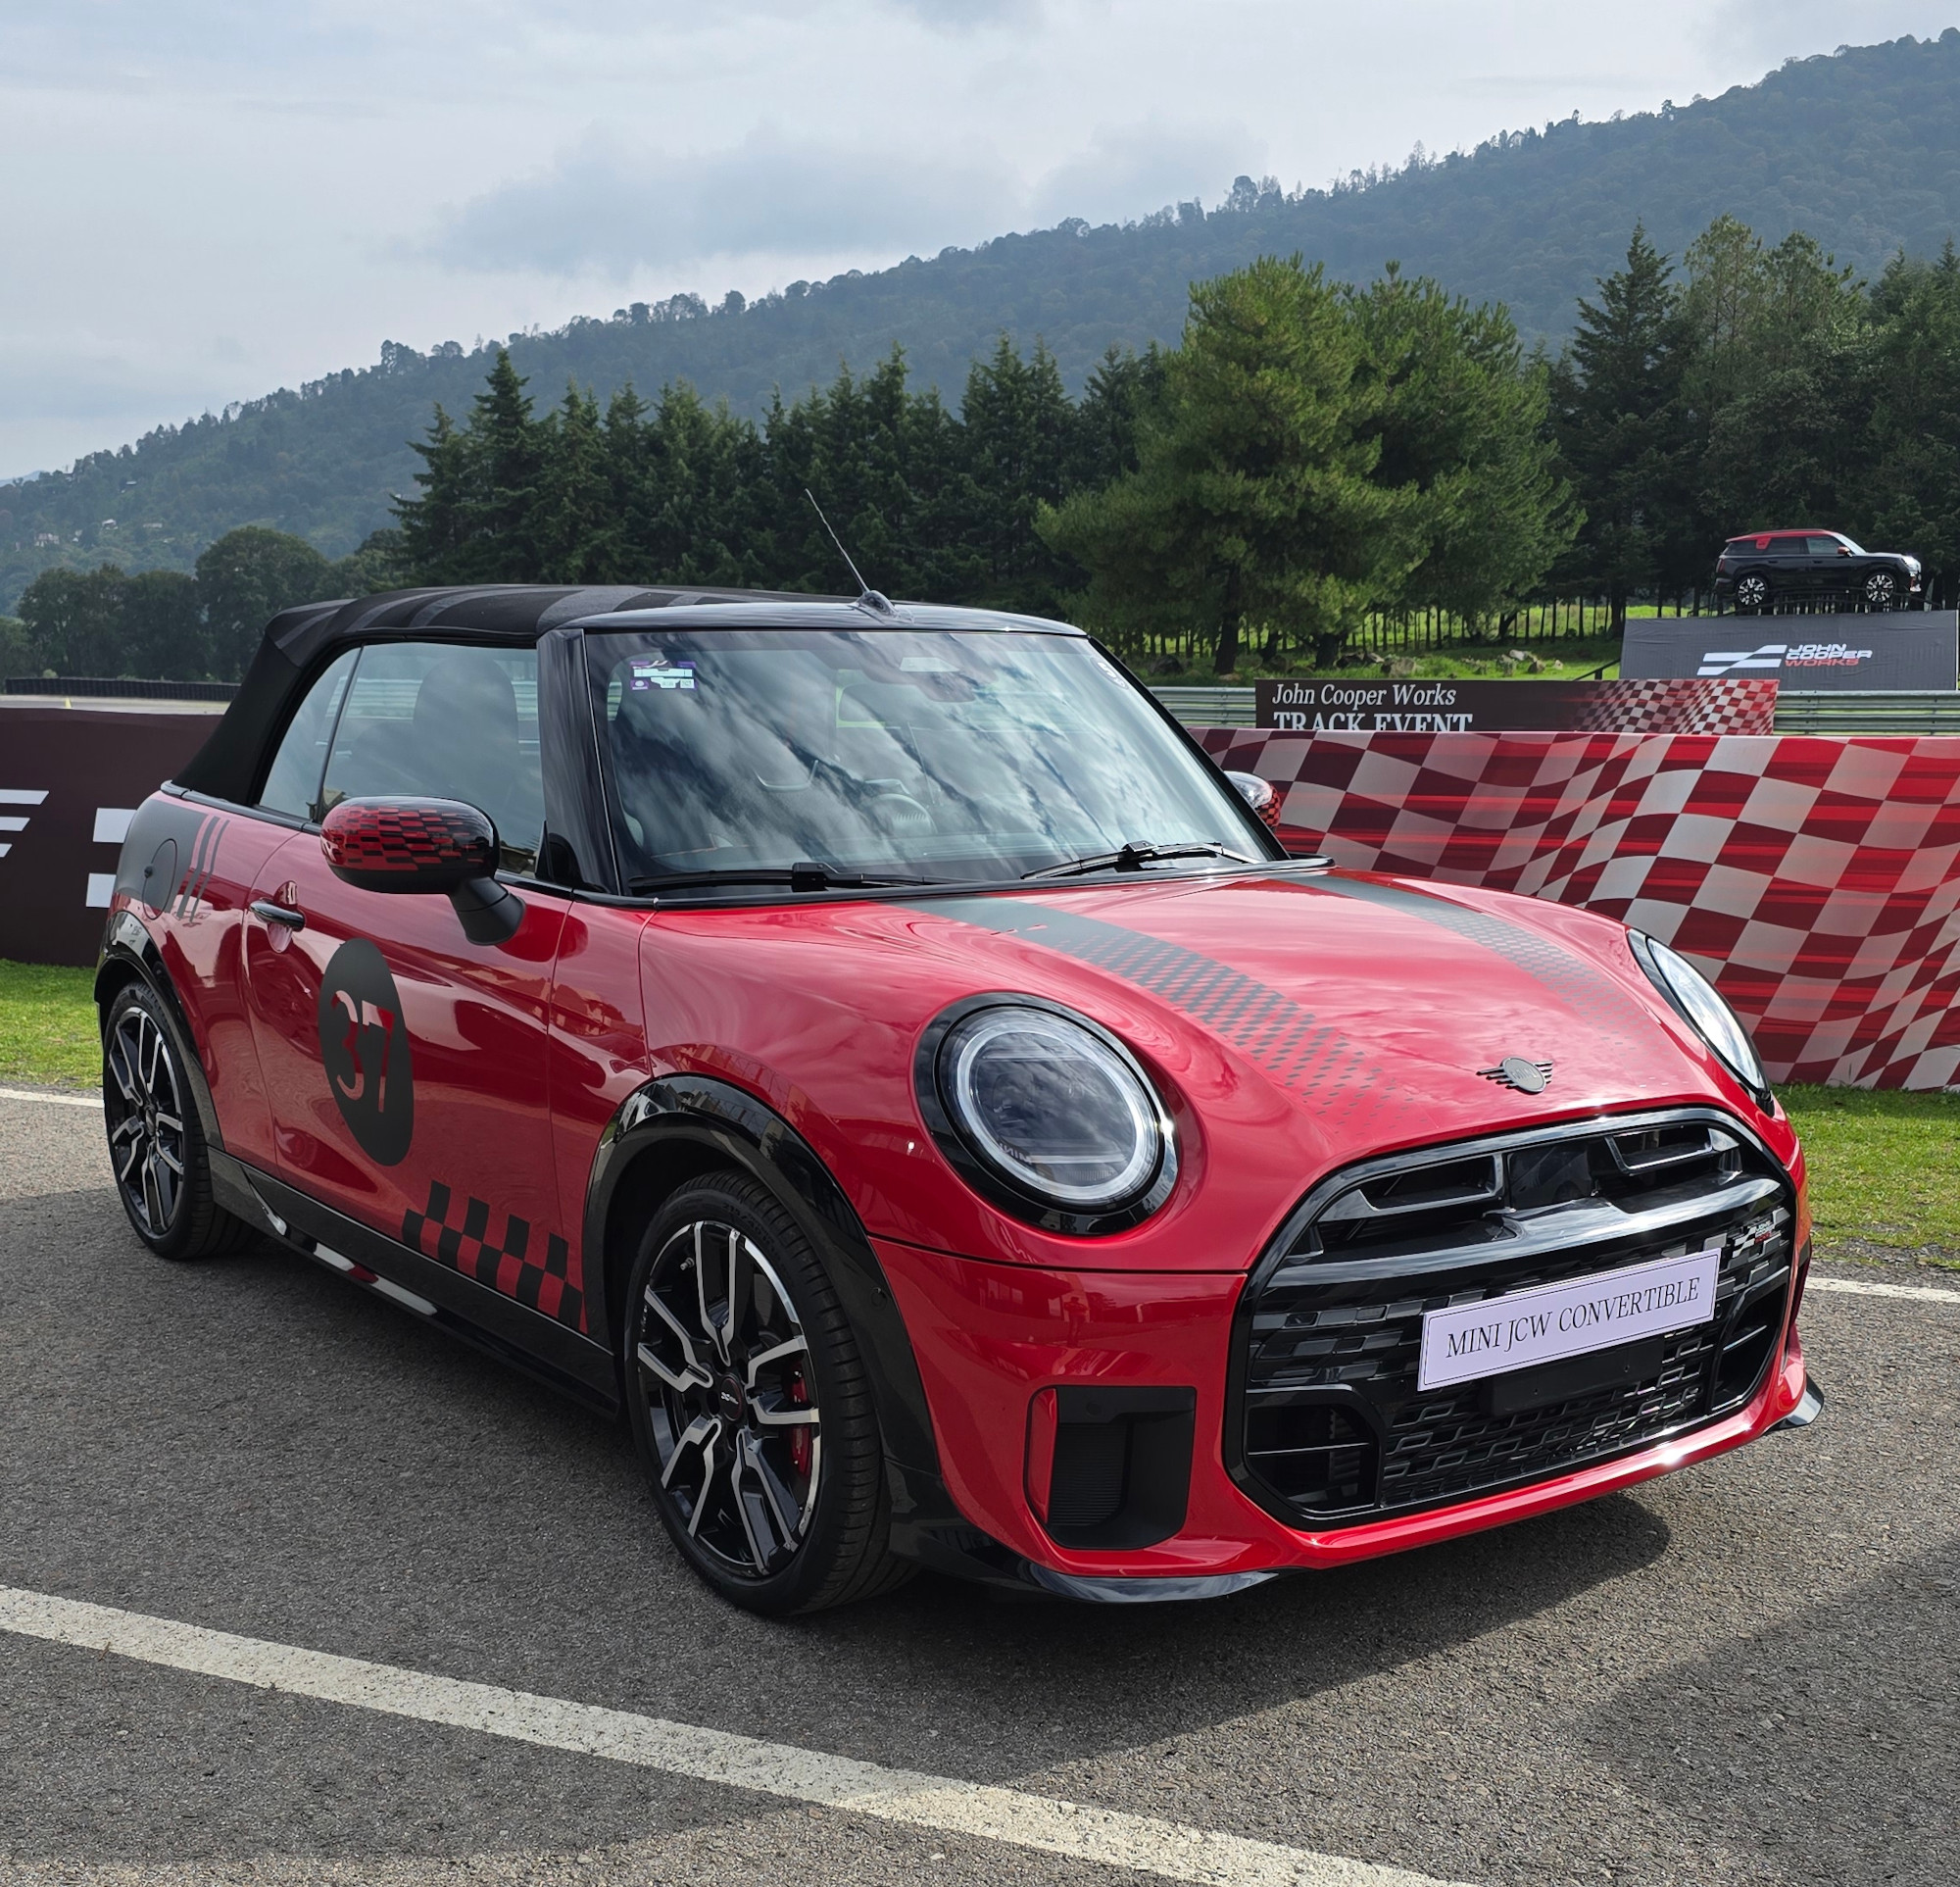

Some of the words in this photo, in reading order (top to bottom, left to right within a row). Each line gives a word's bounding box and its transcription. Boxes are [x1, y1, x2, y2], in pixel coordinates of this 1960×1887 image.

[1786, 650, 1872, 660] COOPER
[1788, 643, 1846, 652] JOHN
[1272, 683, 1315, 705] John
[1320, 683, 1387, 711] Cooper
[1393, 683, 1456, 706] Works
[1273, 711, 1365, 730] TRACK
[1373, 713, 1473, 731] EVENT
[331, 990, 395, 1113] 37
[1446, 1321, 1502, 1359] MINI
[1504, 1311, 1553, 1353] JCW
[1558, 1276, 1700, 1332] CONVERTIBLE
